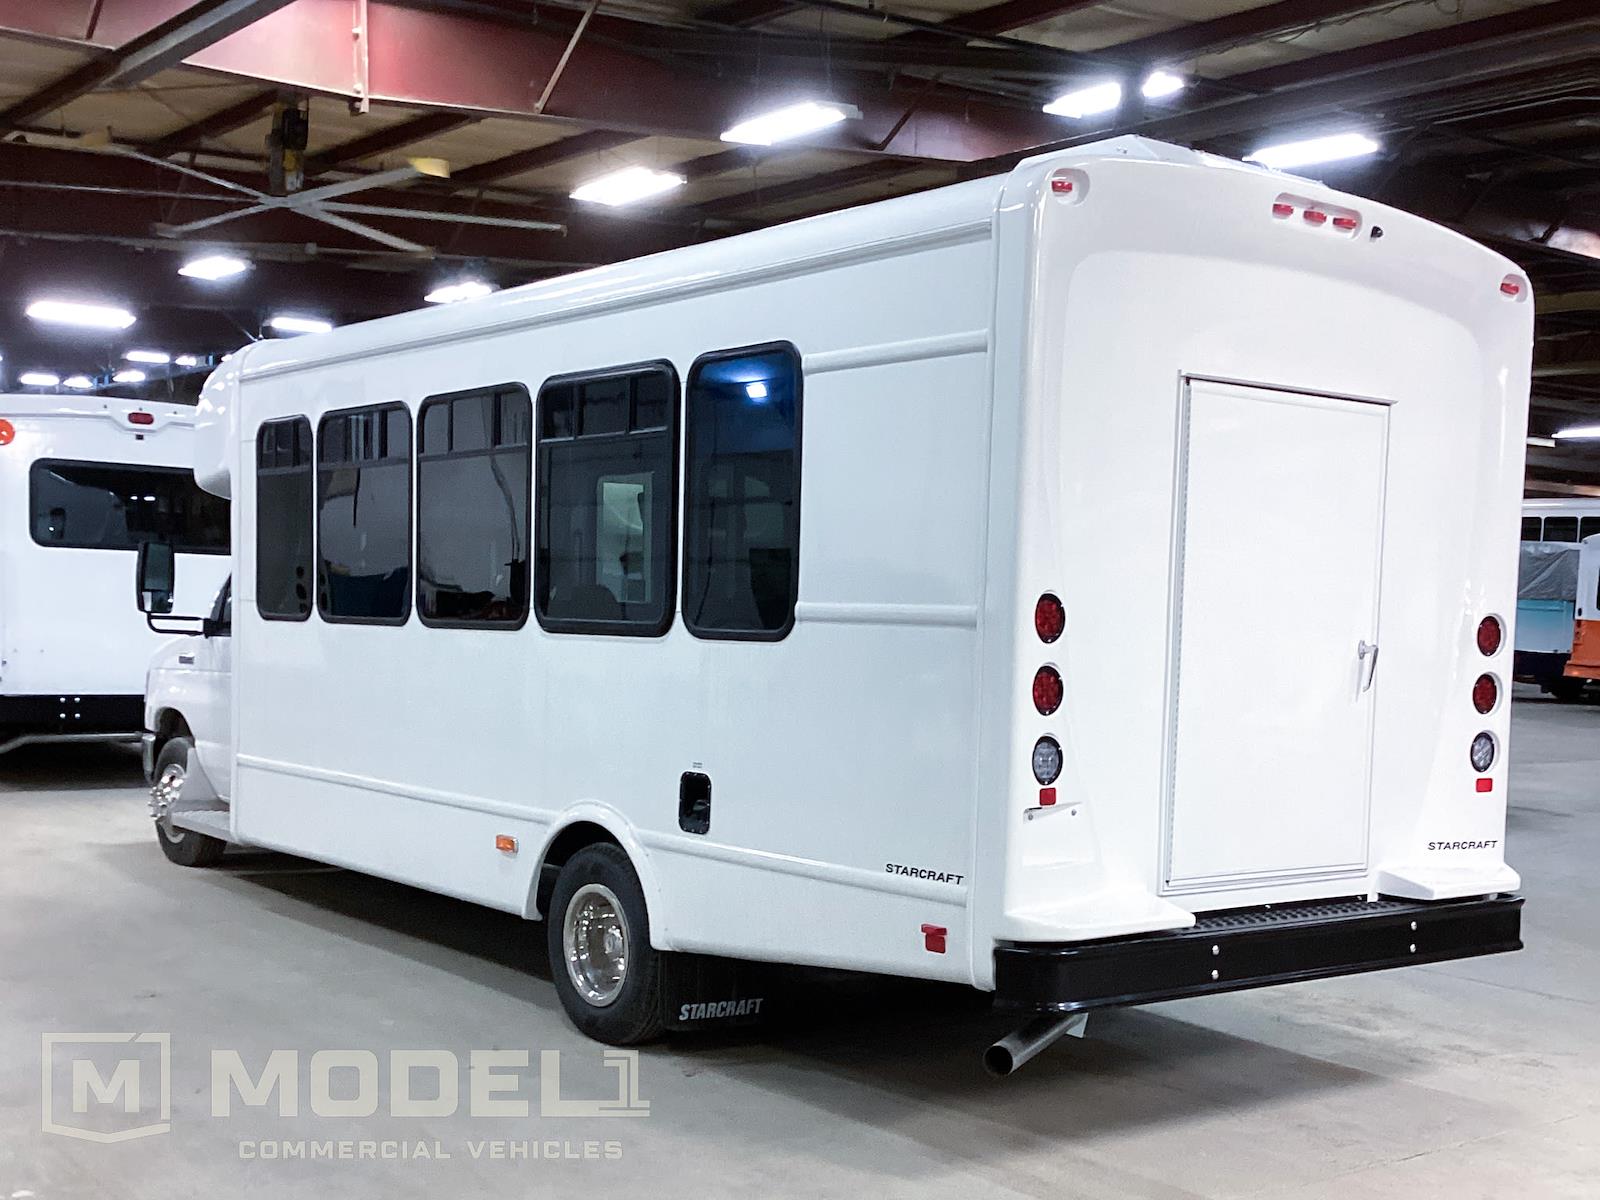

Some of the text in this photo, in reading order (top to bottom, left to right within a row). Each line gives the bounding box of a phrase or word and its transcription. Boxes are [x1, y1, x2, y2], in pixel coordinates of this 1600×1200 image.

[1427, 840, 1498, 850] STARCRAFT
[885, 863, 964, 885] STARCRAFT
[679, 998, 763, 1020] STARCRAFT
